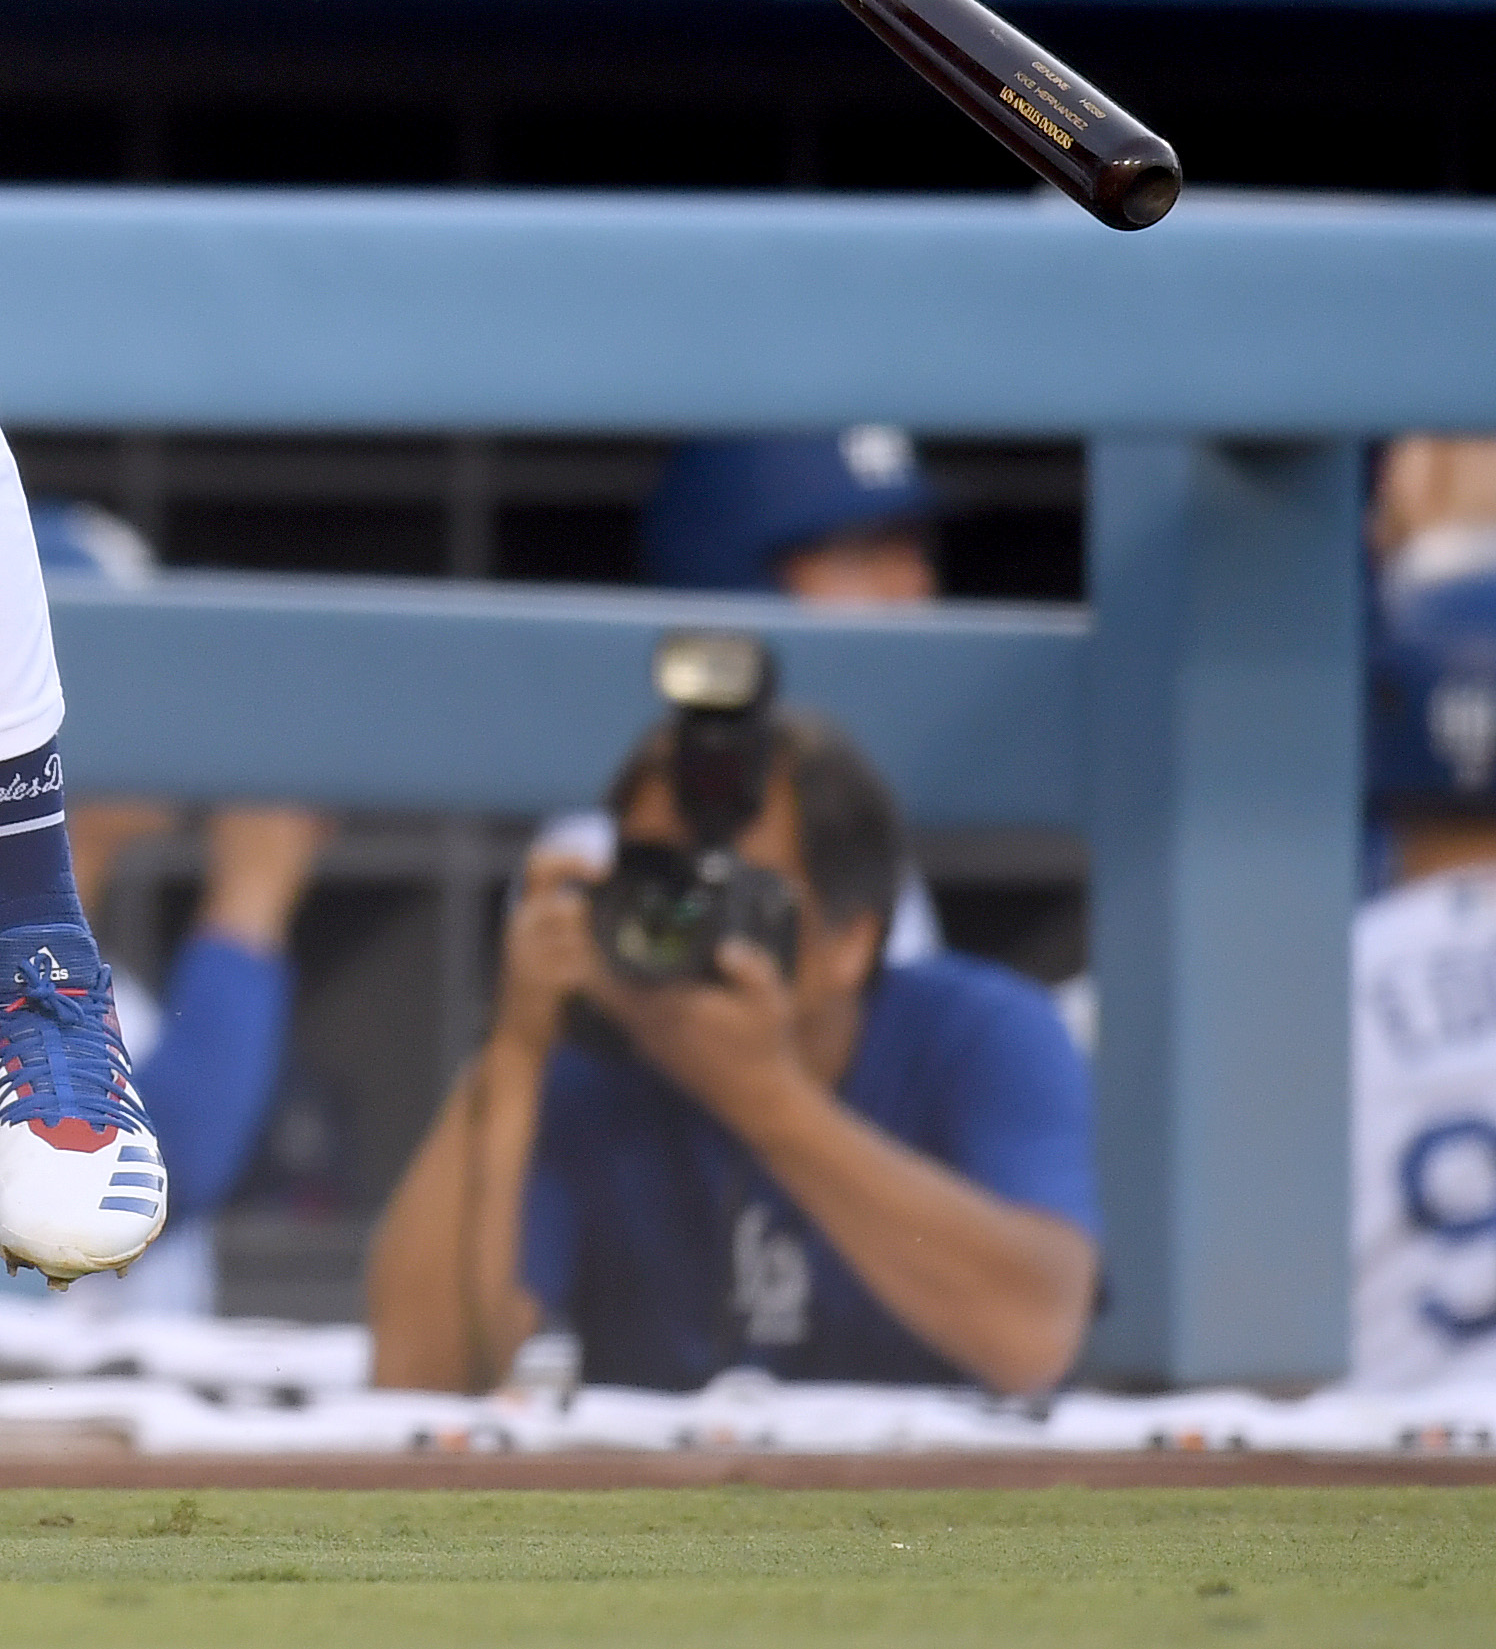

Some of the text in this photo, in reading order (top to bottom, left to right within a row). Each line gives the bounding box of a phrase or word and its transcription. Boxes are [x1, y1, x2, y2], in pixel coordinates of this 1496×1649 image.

[999, 85, 1075, 151] LOS ANGELES DODGERS
[1014, 70, 1090, 132] KIKE HERNANDEZ
